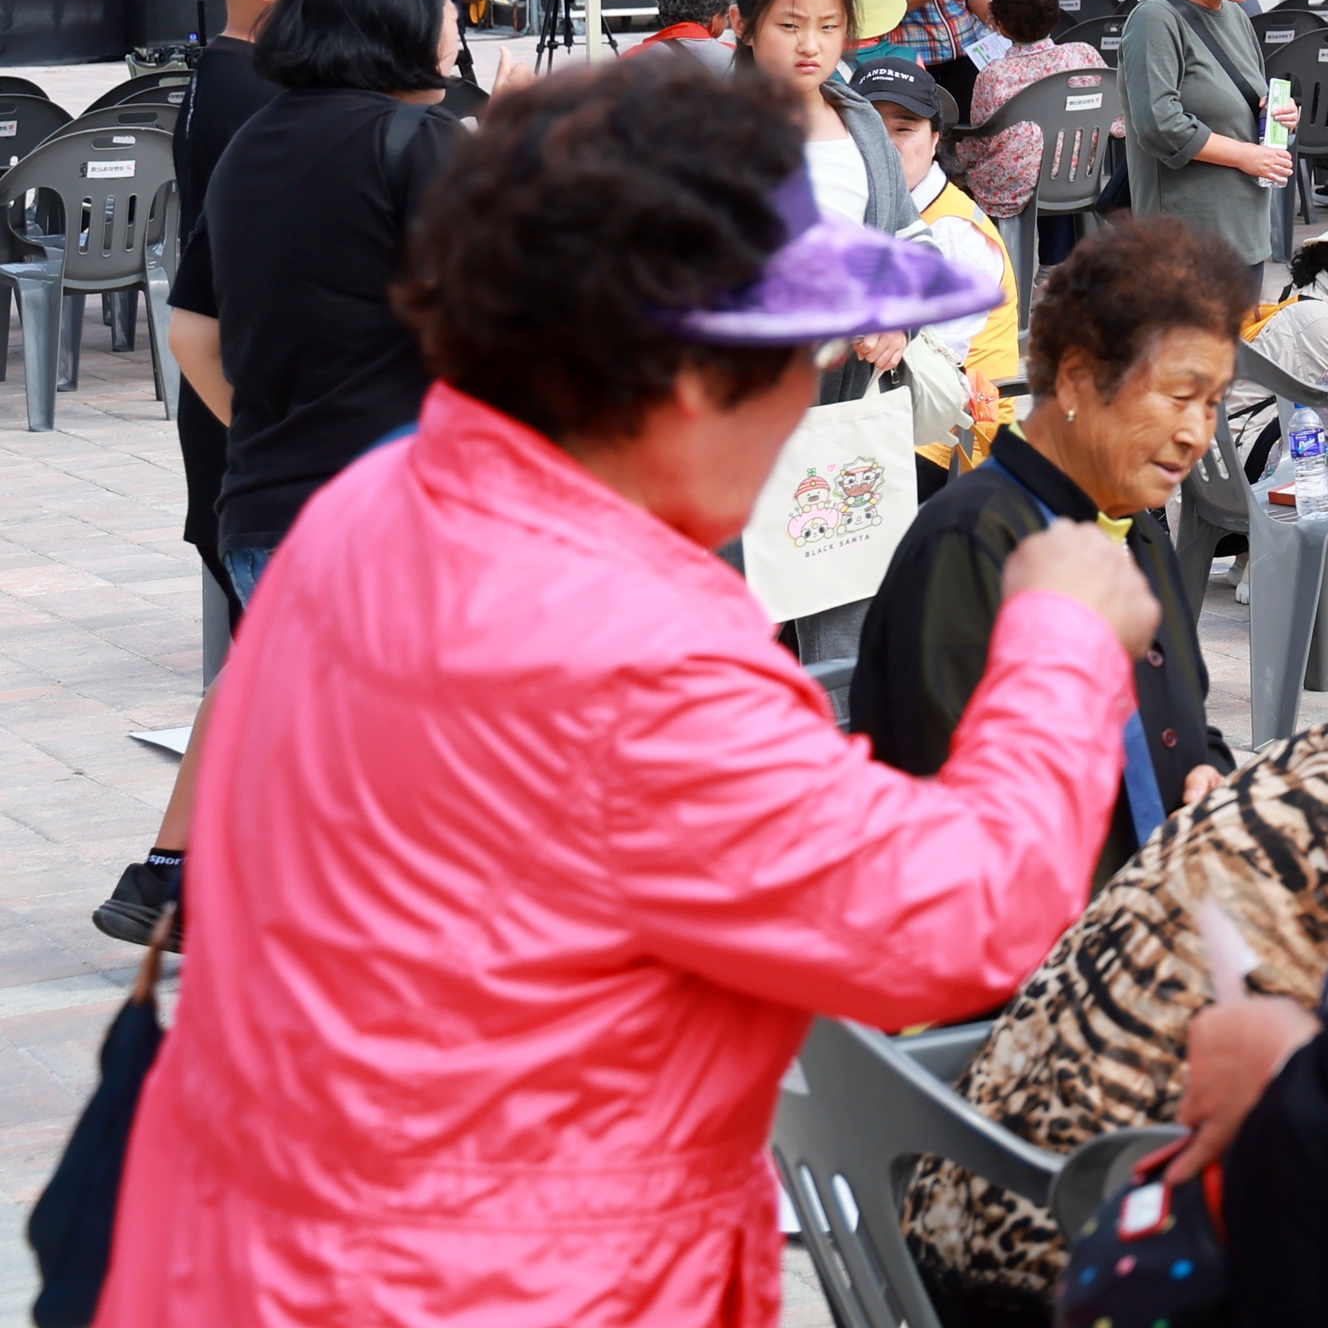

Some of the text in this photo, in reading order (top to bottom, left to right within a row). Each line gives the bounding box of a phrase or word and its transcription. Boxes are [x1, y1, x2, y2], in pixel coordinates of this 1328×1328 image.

[866, 68, 915, 83] ANDREWS
[805, 533, 871, 558] BLACK SANTA
[149, 854, 187, 865] spor
